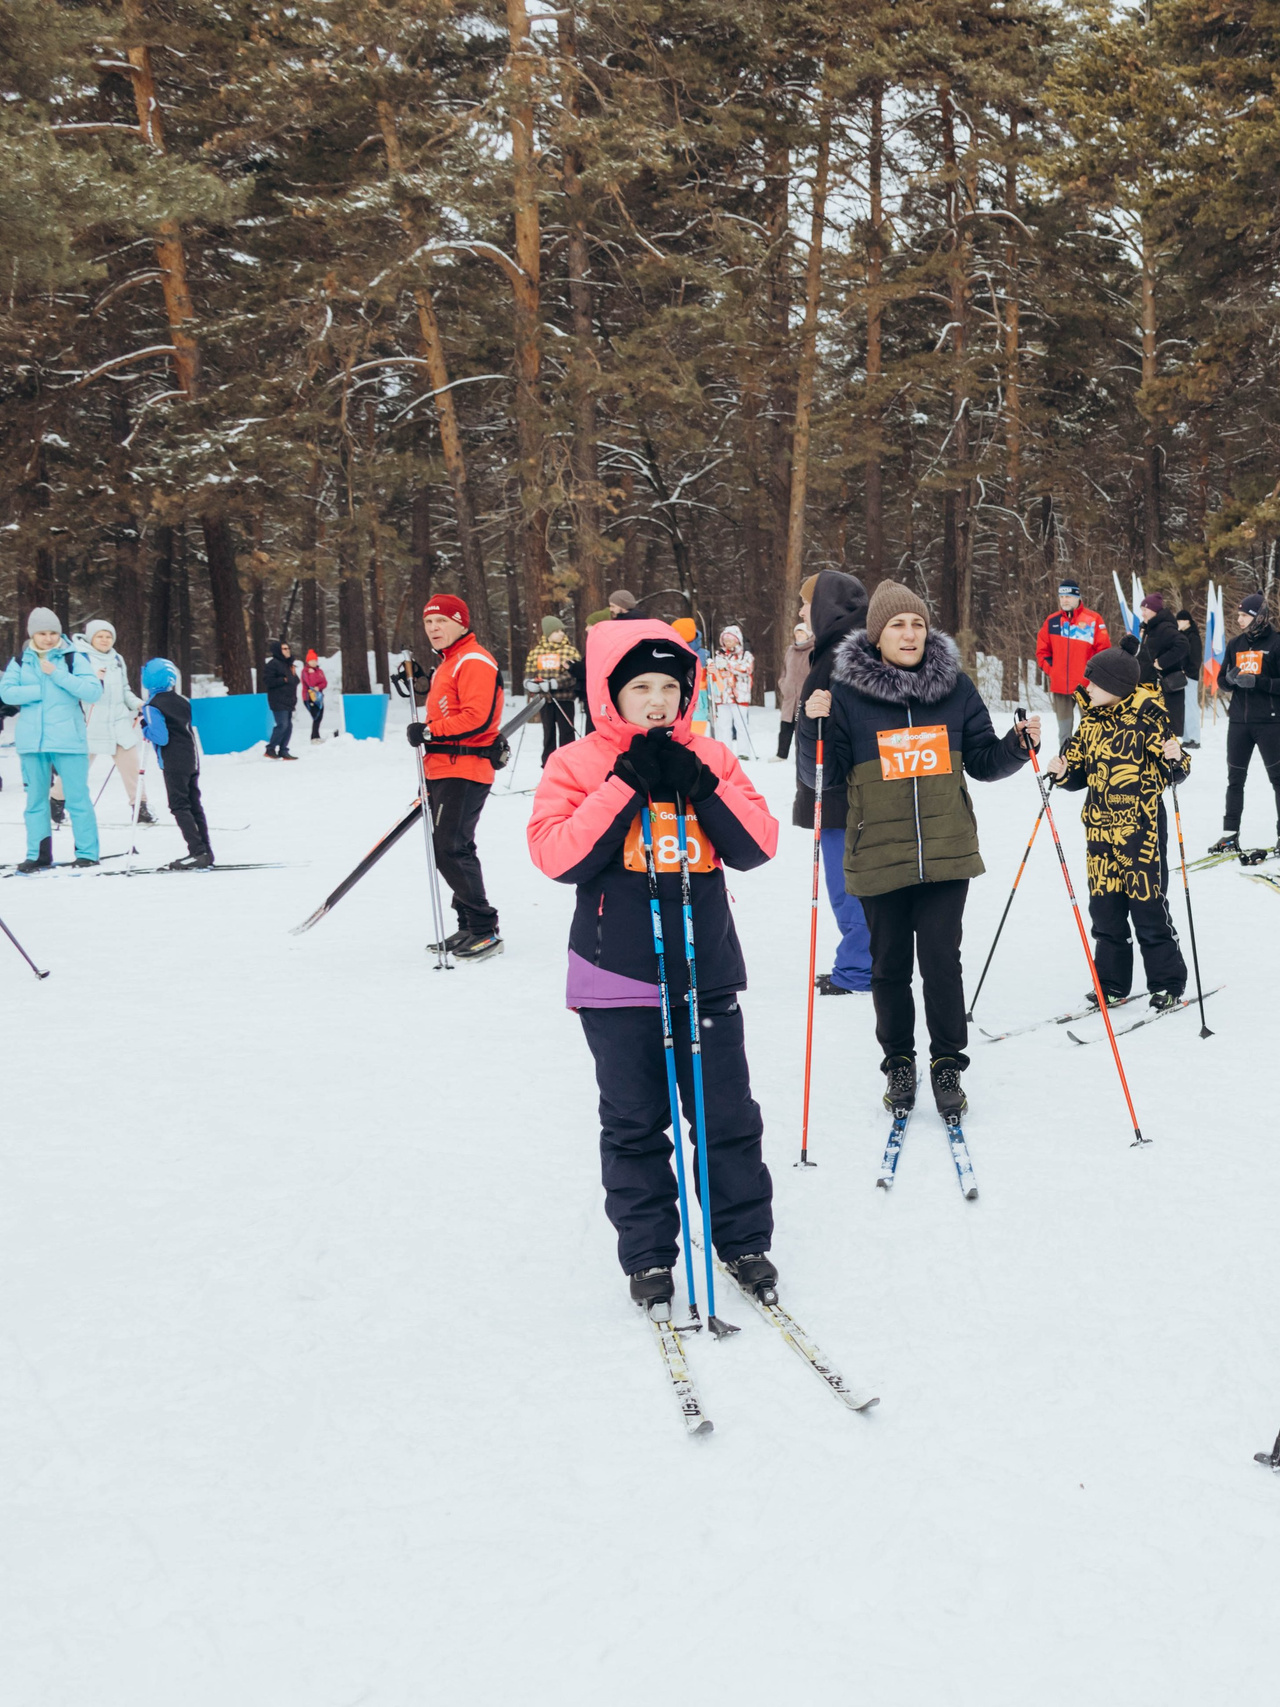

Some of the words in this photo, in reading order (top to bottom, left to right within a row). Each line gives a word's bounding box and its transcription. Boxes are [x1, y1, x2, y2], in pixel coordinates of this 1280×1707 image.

[904, 732, 937, 741] Goodline
[893, 749, 938, 773] 179
[643, 835, 701, 865] 80
